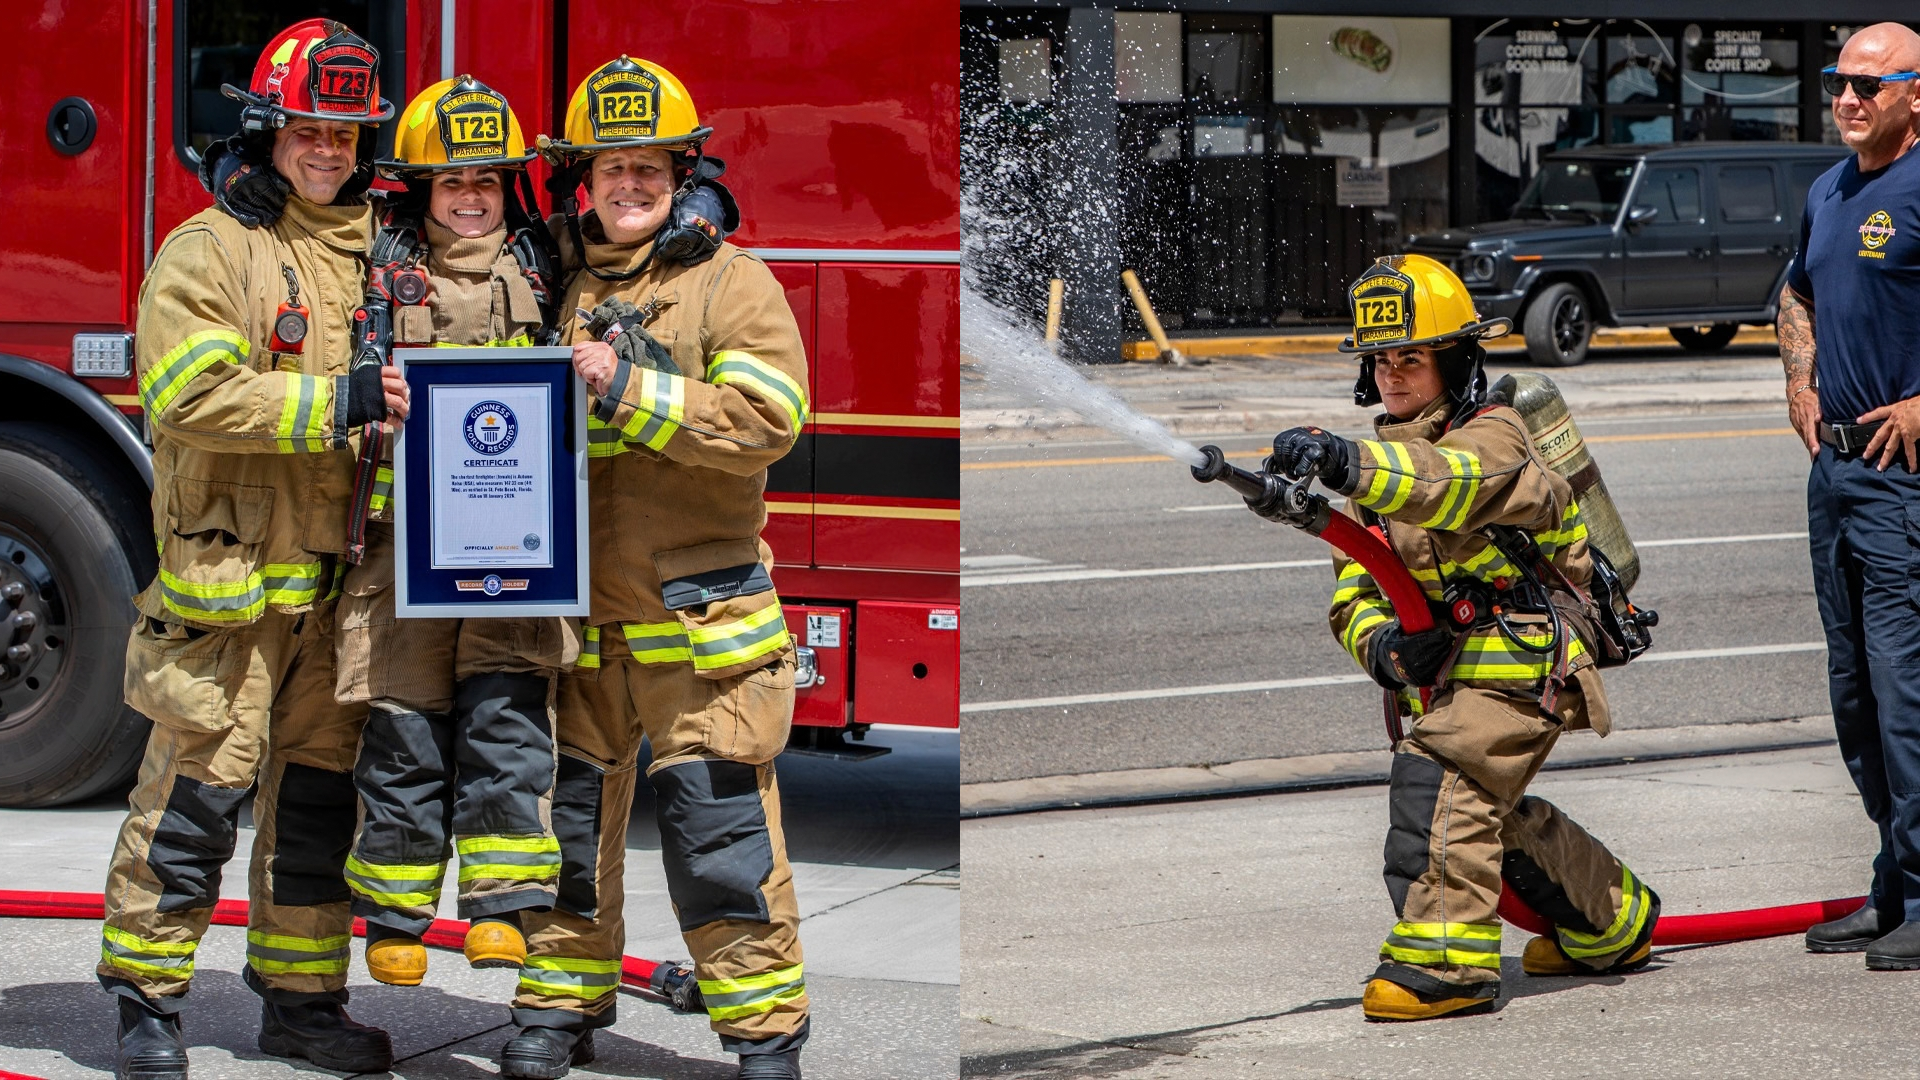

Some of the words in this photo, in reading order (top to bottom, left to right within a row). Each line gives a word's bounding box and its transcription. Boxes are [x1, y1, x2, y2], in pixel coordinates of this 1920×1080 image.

[1516, 30, 1558, 43] SERVING
[1714, 30, 1762, 43] SPECIALTY
[1506, 45, 1544, 58] COFFEE
[1546, 45, 1568, 58] AND
[1715, 44, 1739, 57] SURF
[1740, 44, 1762, 57] AND
[1506, 60, 1540, 73] GOOD
[1705, 58, 1741, 72] COFFEE
[1743, 58, 1772, 72] SHOP
[326, 70, 367, 95] T23
[597, 79, 608, 88] ST.
[607, 72, 626, 82] PETE
[627, 73, 651, 86] BEACH
[446, 100, 456, 109] ST.
[456, 94, 475, 104] PETE
[475, 94, 498, 107] BEACH
[602, 95, 647, 120] R23
[455, 116, 499, 140] T23
[602, 126, 648, 135] FIREFIGHTER
[455, 146, 500, 157] PARAMEDIC
[1858, 250, 1886, 259] LIEUTENANT
[1366, 278, 1380, 289] PETE
[1381, 277, 1405, 292] BEACH
[1360, 300, 1398, 325] T23
[1363, 329, 1403, 340] PARAMEDIC
[470, 404, 511, 419] GUINNESS
[466, 424, 485, 451] WORLD
[487, 424, 515, 453] RECORDS
[1541, 428, 1570, 454] SCOTT
[706, 581, 740, 596] Lakeland
